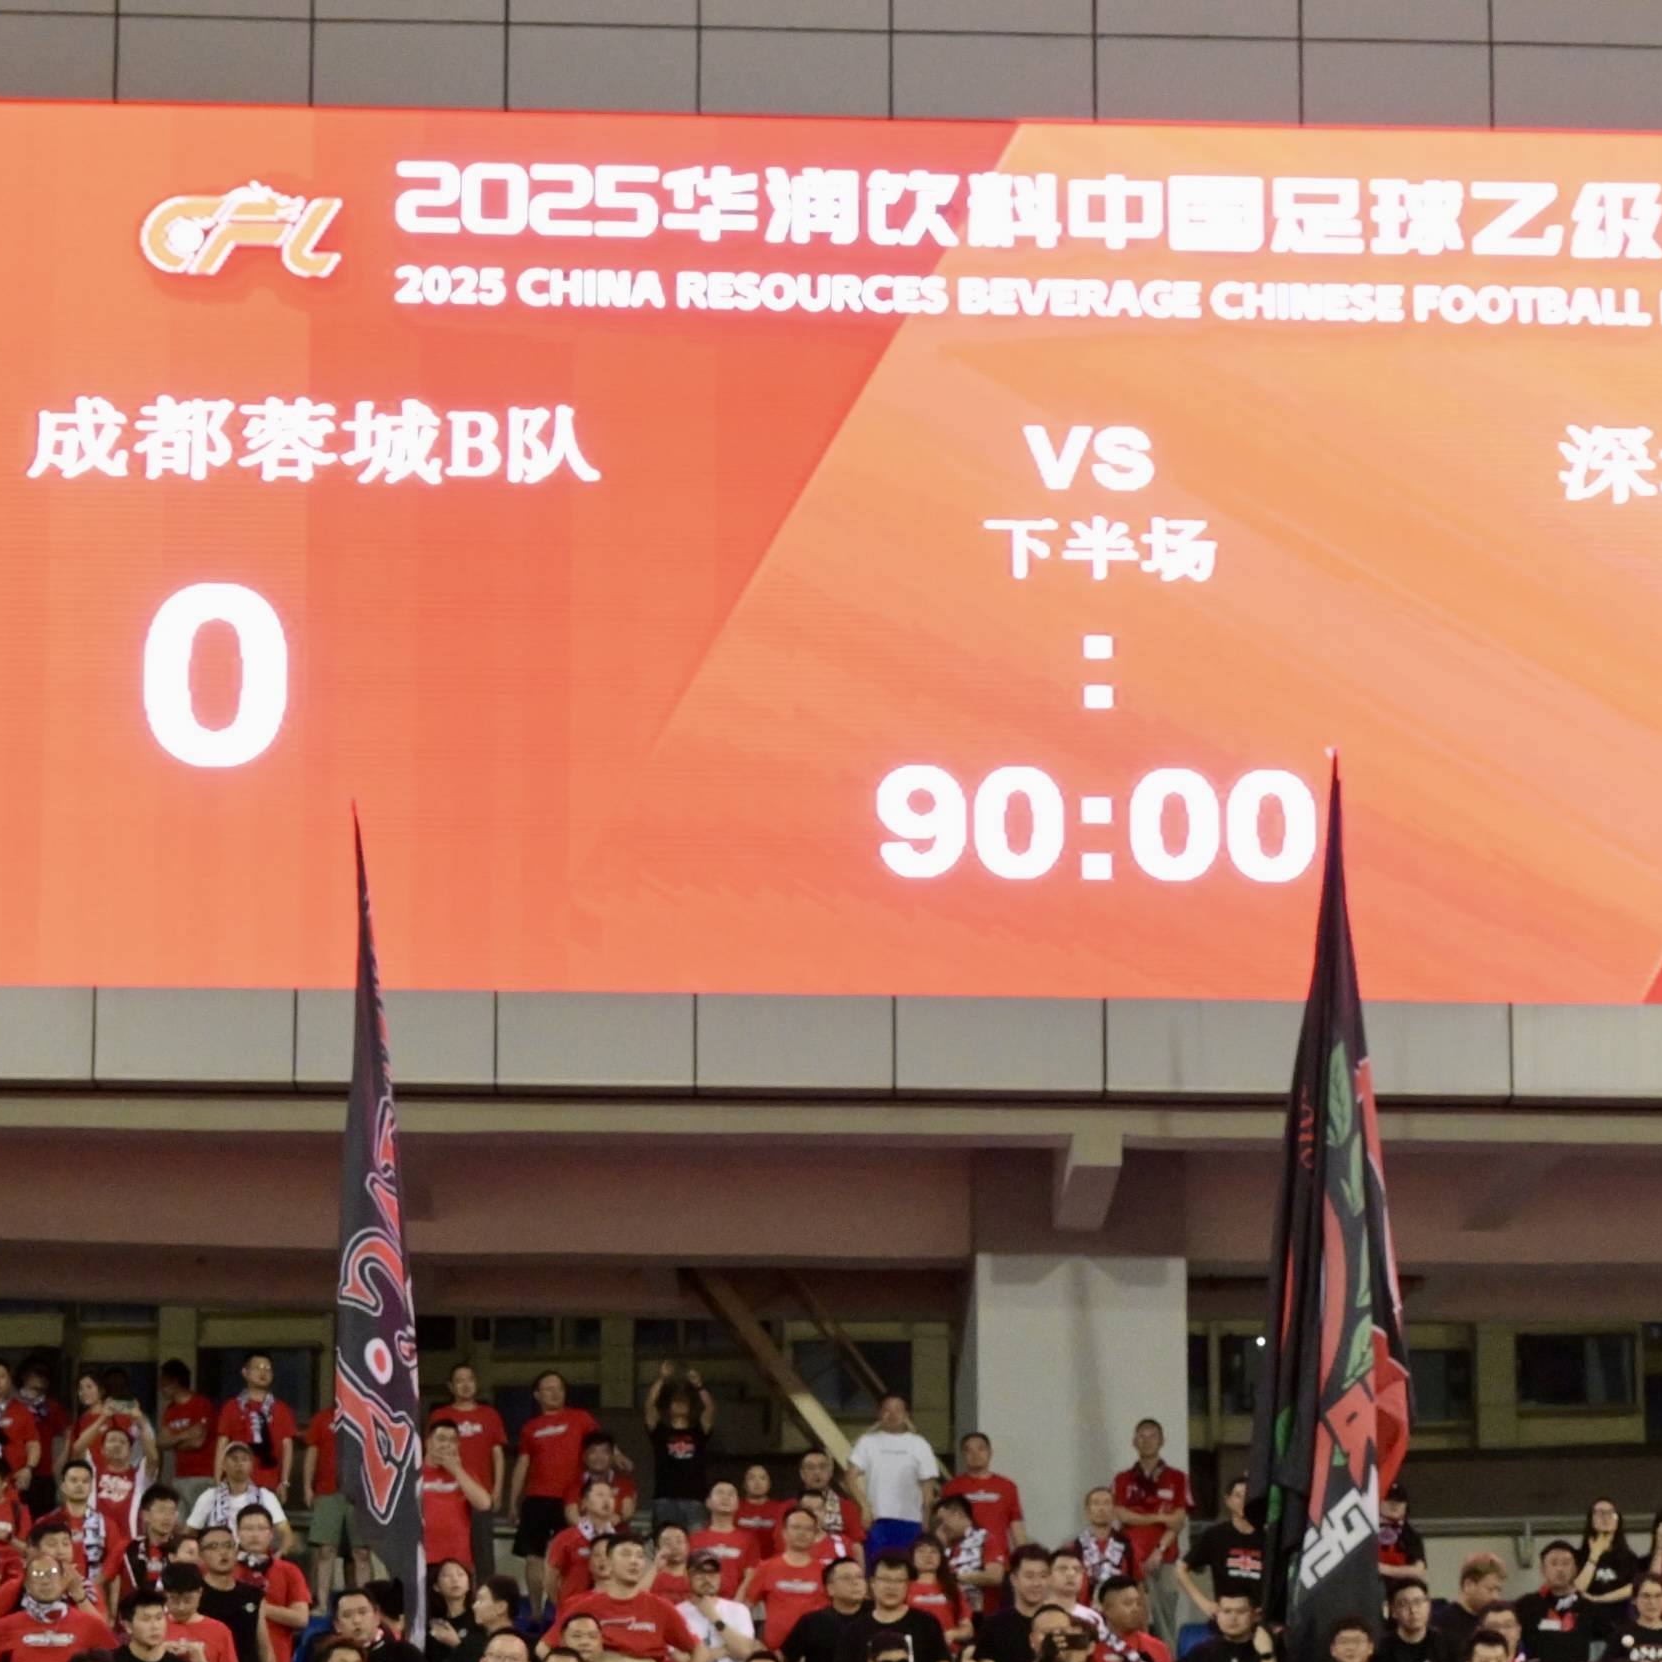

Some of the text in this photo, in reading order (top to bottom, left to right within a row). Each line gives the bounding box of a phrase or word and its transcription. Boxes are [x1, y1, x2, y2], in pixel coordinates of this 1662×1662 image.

[395, 266, 506, 305] 2025
[518, 268, 665, 308] CHINA
[677, 271, 949, 314] RESOURCES
[958, 277, 1202, 319] BEVERAGE
[1210, 281, 1405, 322] CHINESE
[1413, 284, 1652, 326] FOOTBALL
[27, 395, 600, 485] 成都蓉城B队
[1023, 425, 1154, 491] VS
[984, 515, 1217, 582] 下半场
[144, 583, 287, 767] 0
[877, 765, 1316, 882] 90:00
